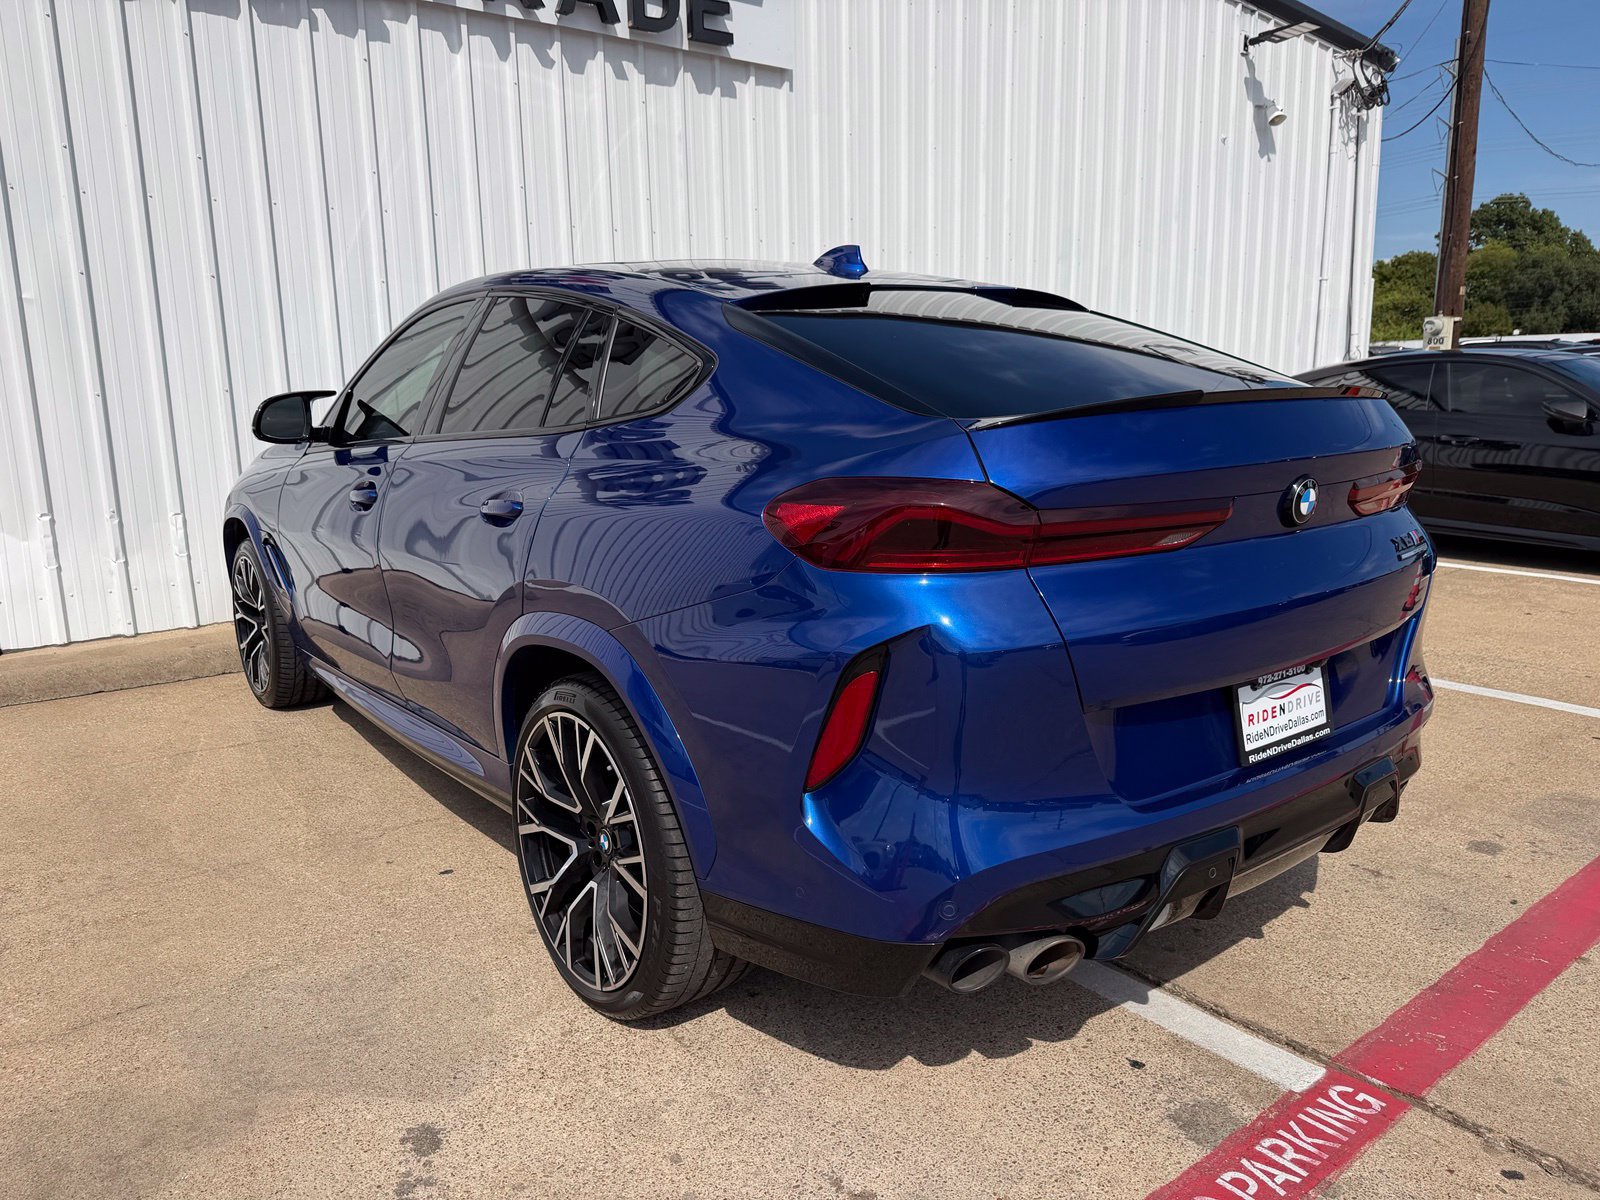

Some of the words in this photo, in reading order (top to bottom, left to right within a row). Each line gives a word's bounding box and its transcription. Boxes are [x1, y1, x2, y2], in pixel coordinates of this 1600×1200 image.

[1257, 664, 1306, 684] 972-271-5100
[1245, 709, 1325, 745] RideNDriveDallas.com
[1248, 727, 1331, 764] RideNDriveDallas.com
[1215, 1085, 1387, 1200] PARKING
